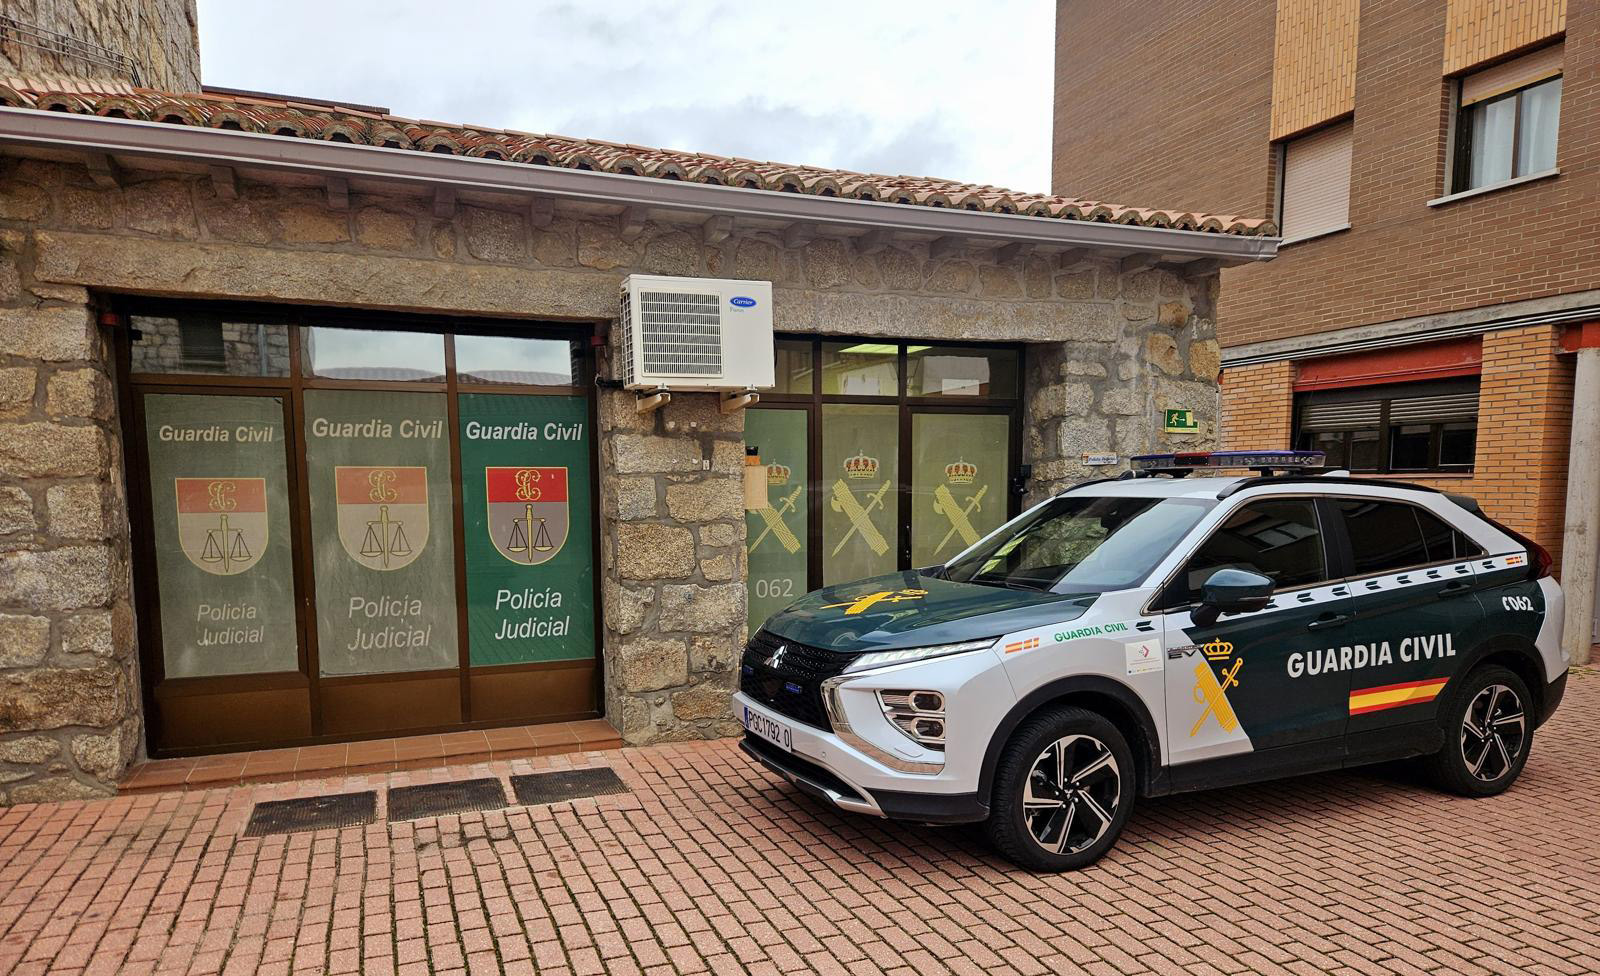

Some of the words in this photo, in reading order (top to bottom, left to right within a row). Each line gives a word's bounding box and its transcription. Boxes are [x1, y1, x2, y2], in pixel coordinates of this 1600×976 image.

[159, 425, 230, 442] Guardia
[235, 426, 274, 442] Civil
[312, 418, 393, 438] Guardia
[399, 419, 443, 439] Civil
[466, 421, 538, 440] Guardia
[543, 422, 583, 441] Civil
[495, 587, 562, 610] Policía
[755, 578, 794, 598] 062
[197, 603, 257, 622] Policía
[348, 594, 422, 618] Policía
[196, 625, 265, 647] Judicial
[347, 624, 432, 651] Judicial
[494, 615, 570, 640] Judicial
[1054, 626, 1103, 642] GUARDIA
[1104, 622, 1128, 633] CIVIL
[1287, 641, 1393, 679] GUARDIA
[1400, 633, 1457, 663] CIVIL
